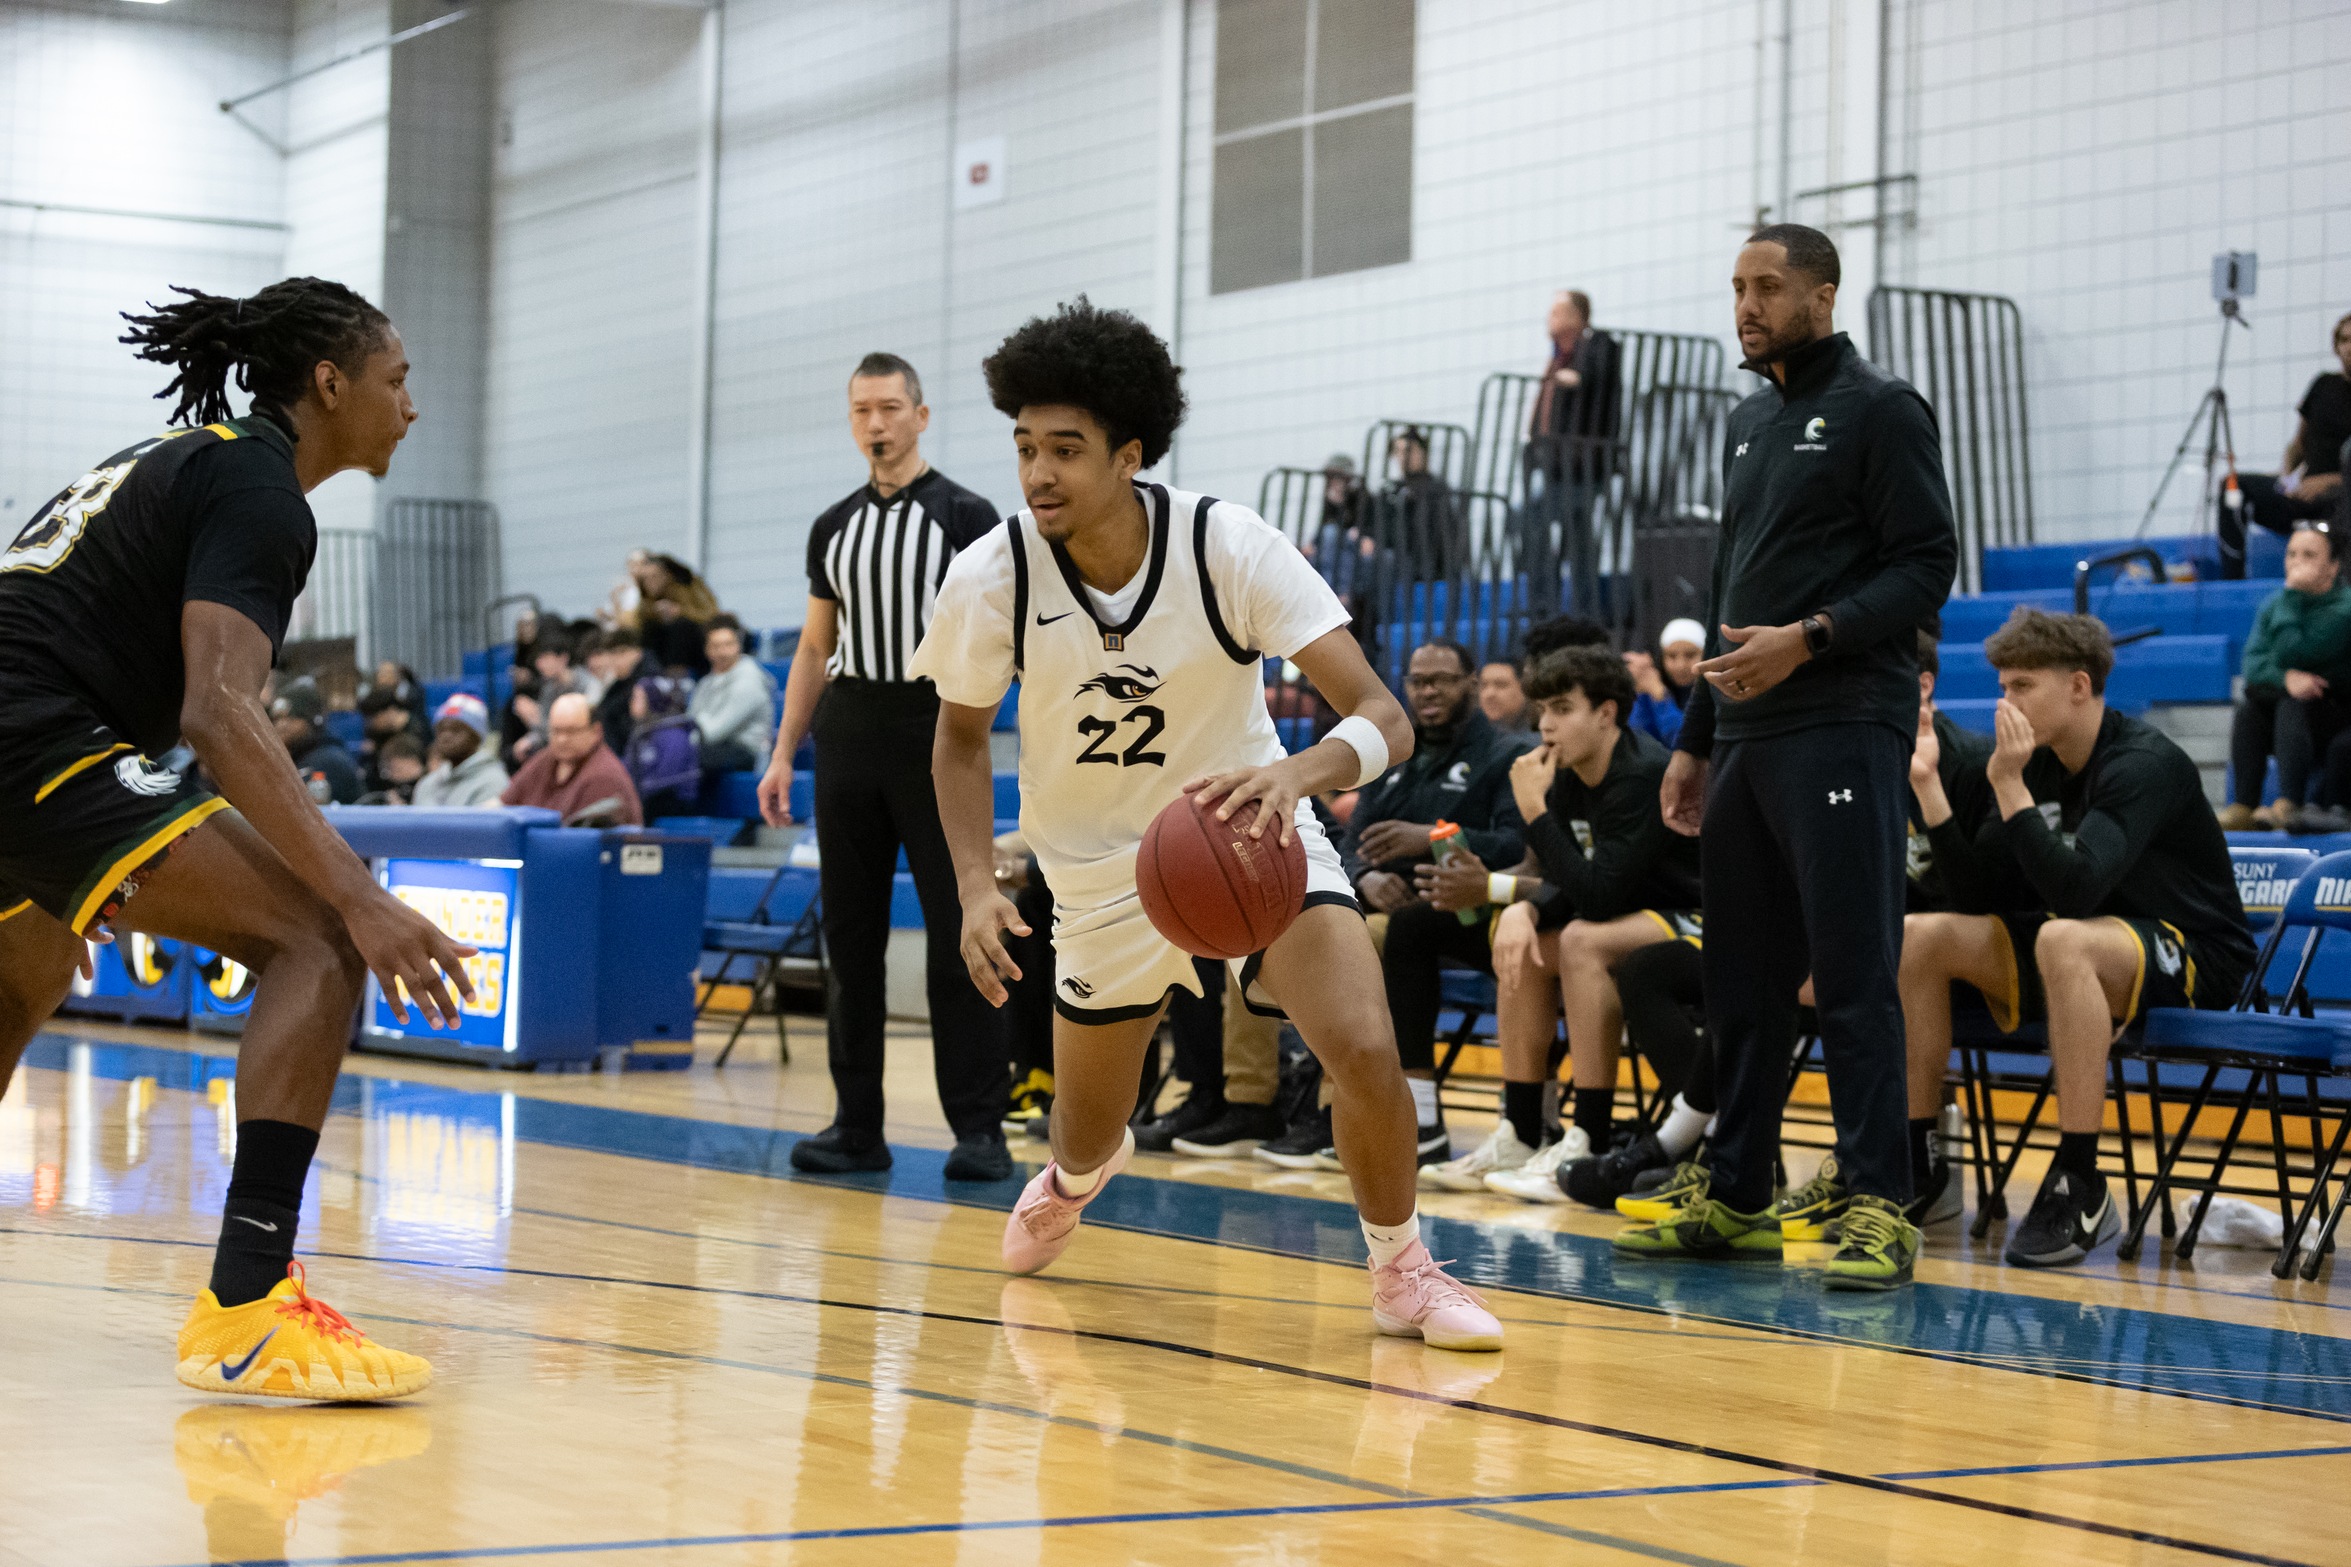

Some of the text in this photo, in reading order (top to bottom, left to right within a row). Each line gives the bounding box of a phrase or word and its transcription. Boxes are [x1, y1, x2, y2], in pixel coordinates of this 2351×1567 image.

[1076, 705, 1166, 767] 22
[1231, 841, 1260, 882] LEGACY
[2233, 862, 2278, 880] SUNY
